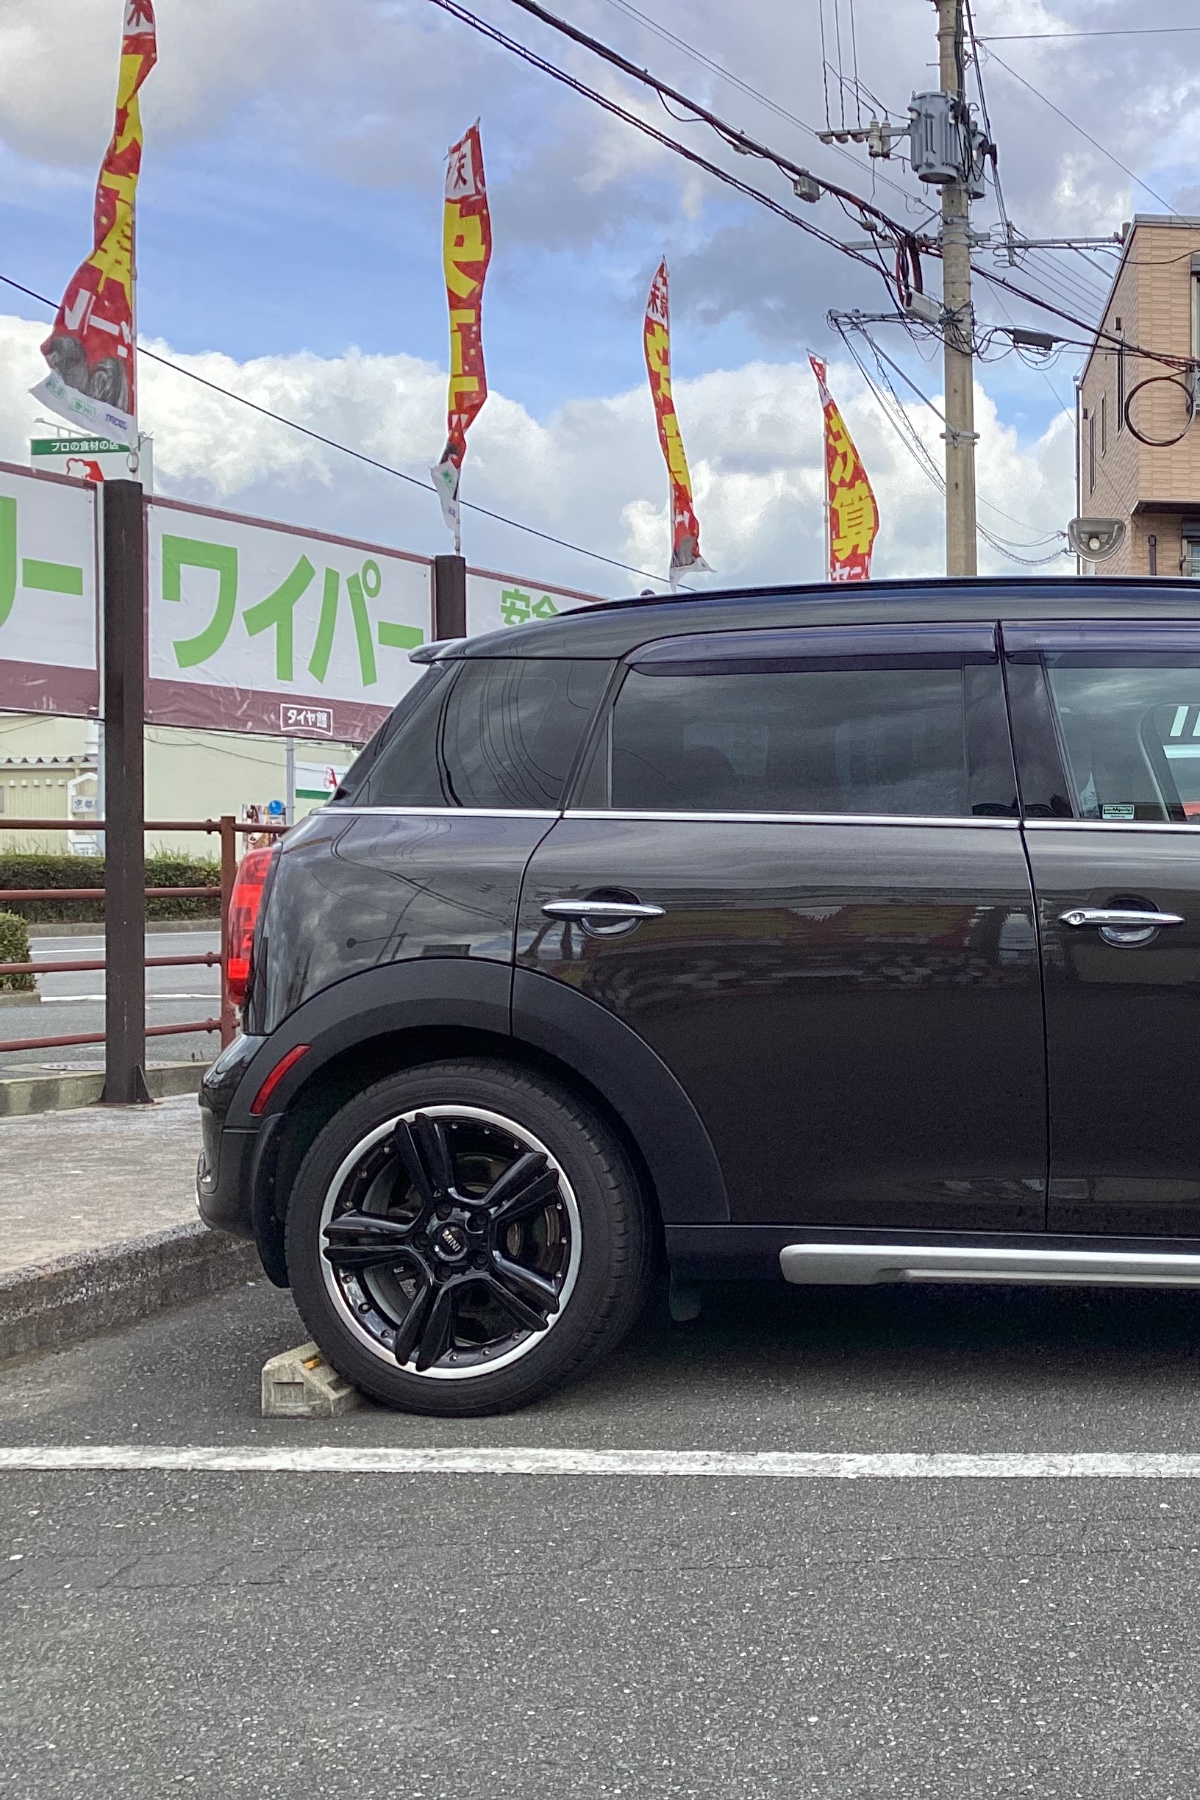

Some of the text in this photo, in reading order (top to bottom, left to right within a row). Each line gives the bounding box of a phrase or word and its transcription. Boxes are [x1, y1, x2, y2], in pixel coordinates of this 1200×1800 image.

[162, 533, 425, 688] ワイパー
[287, 709, 328, 728] タイヤ館
[442, 1228, 461, 1252] MINI
